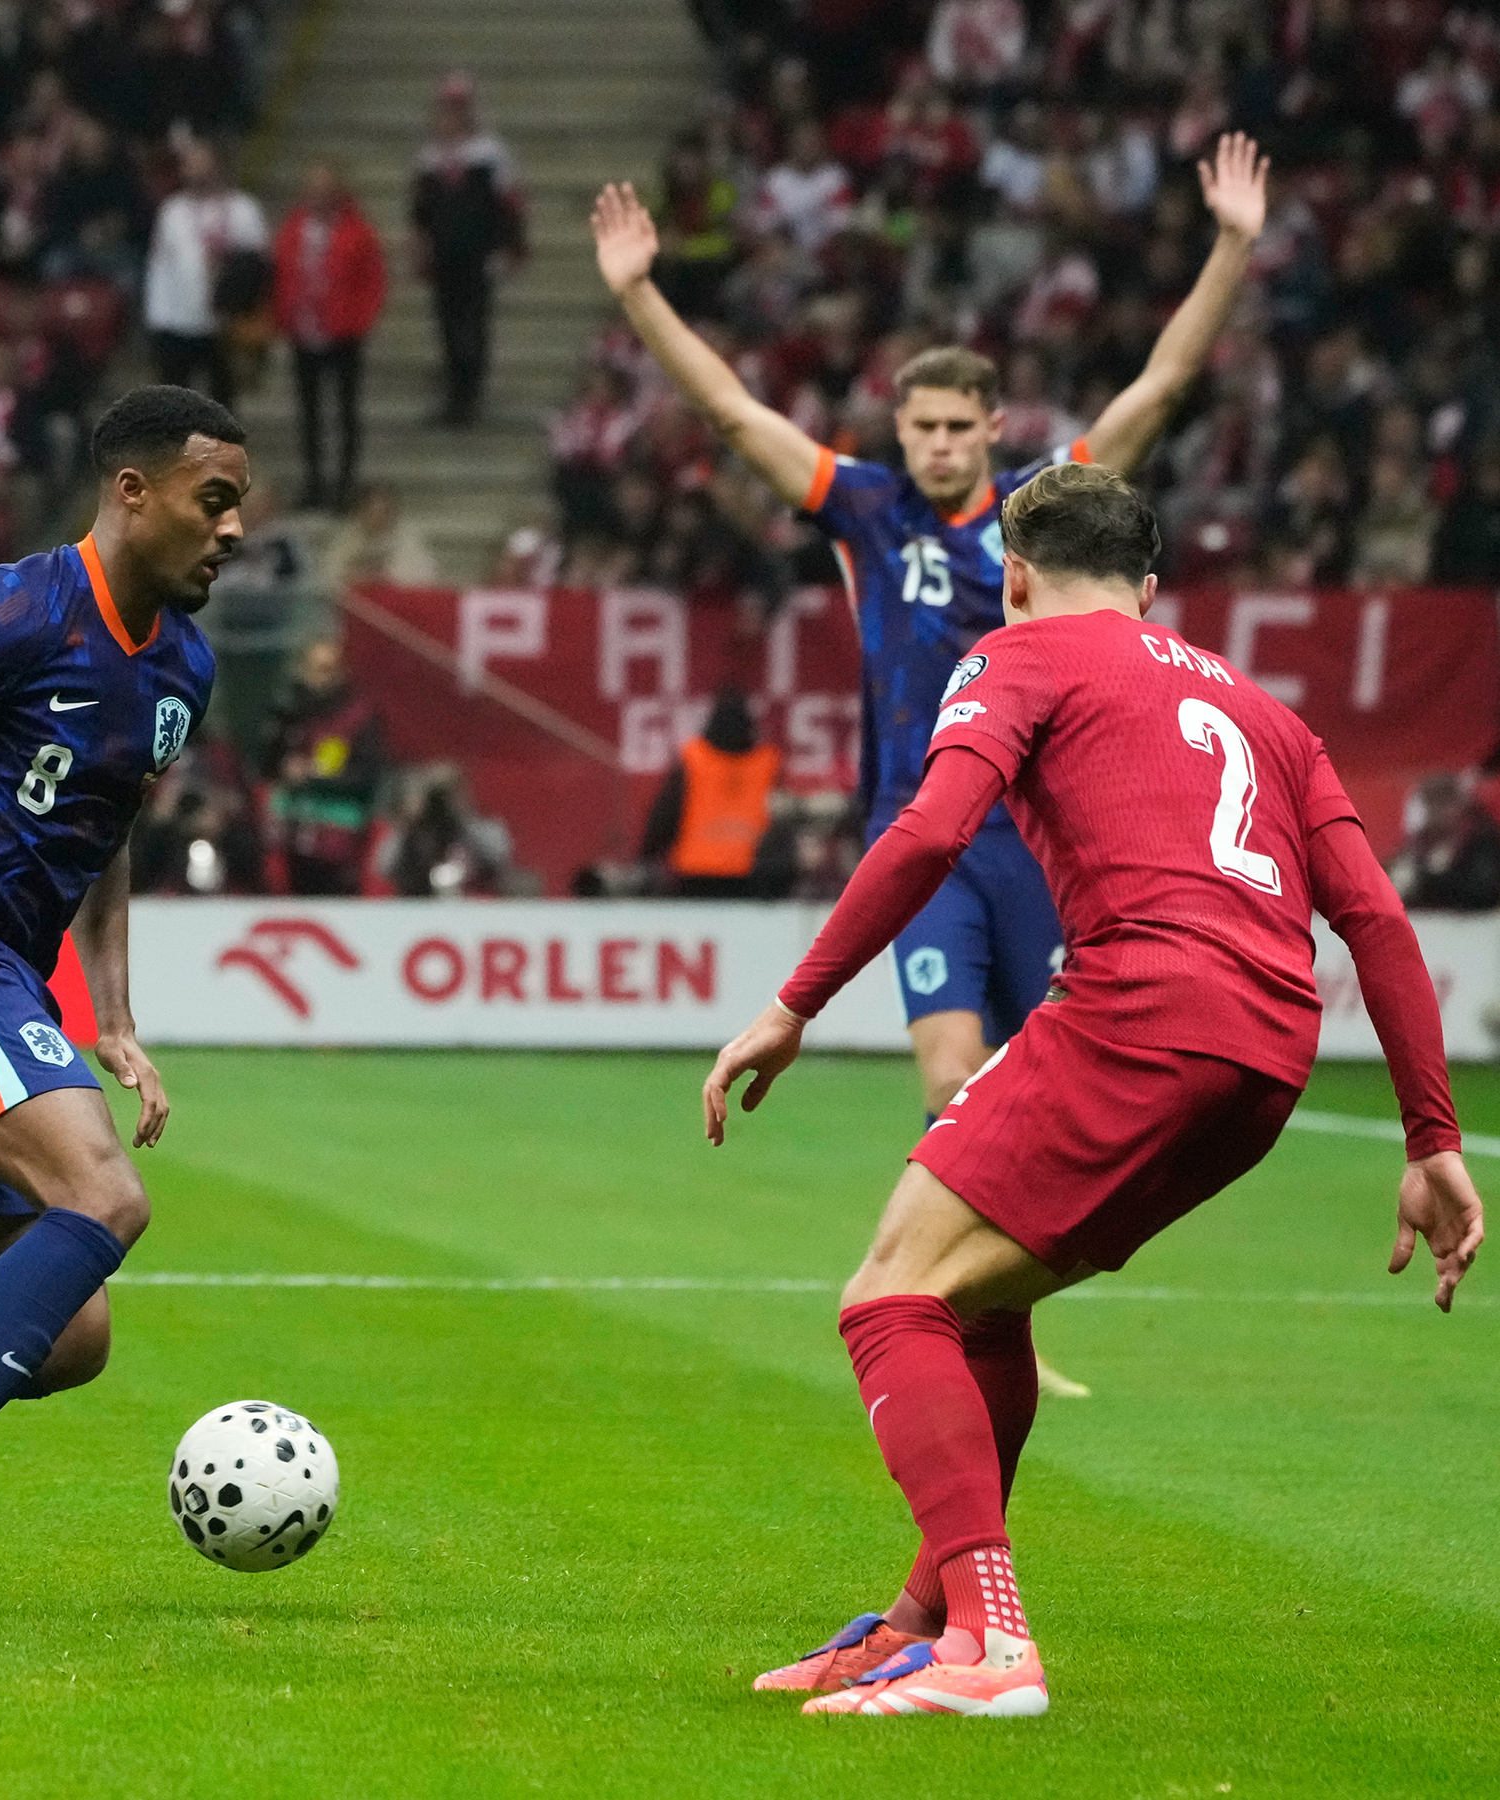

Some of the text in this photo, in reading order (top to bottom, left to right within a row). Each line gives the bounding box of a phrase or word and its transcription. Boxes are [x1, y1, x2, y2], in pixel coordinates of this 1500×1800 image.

[900, 536, 954, 607] 15
[16, 743, 74, 816] 8
[1177, 697, 1283, 897] 2
[401, 935, 717, 1004] ORLEN
